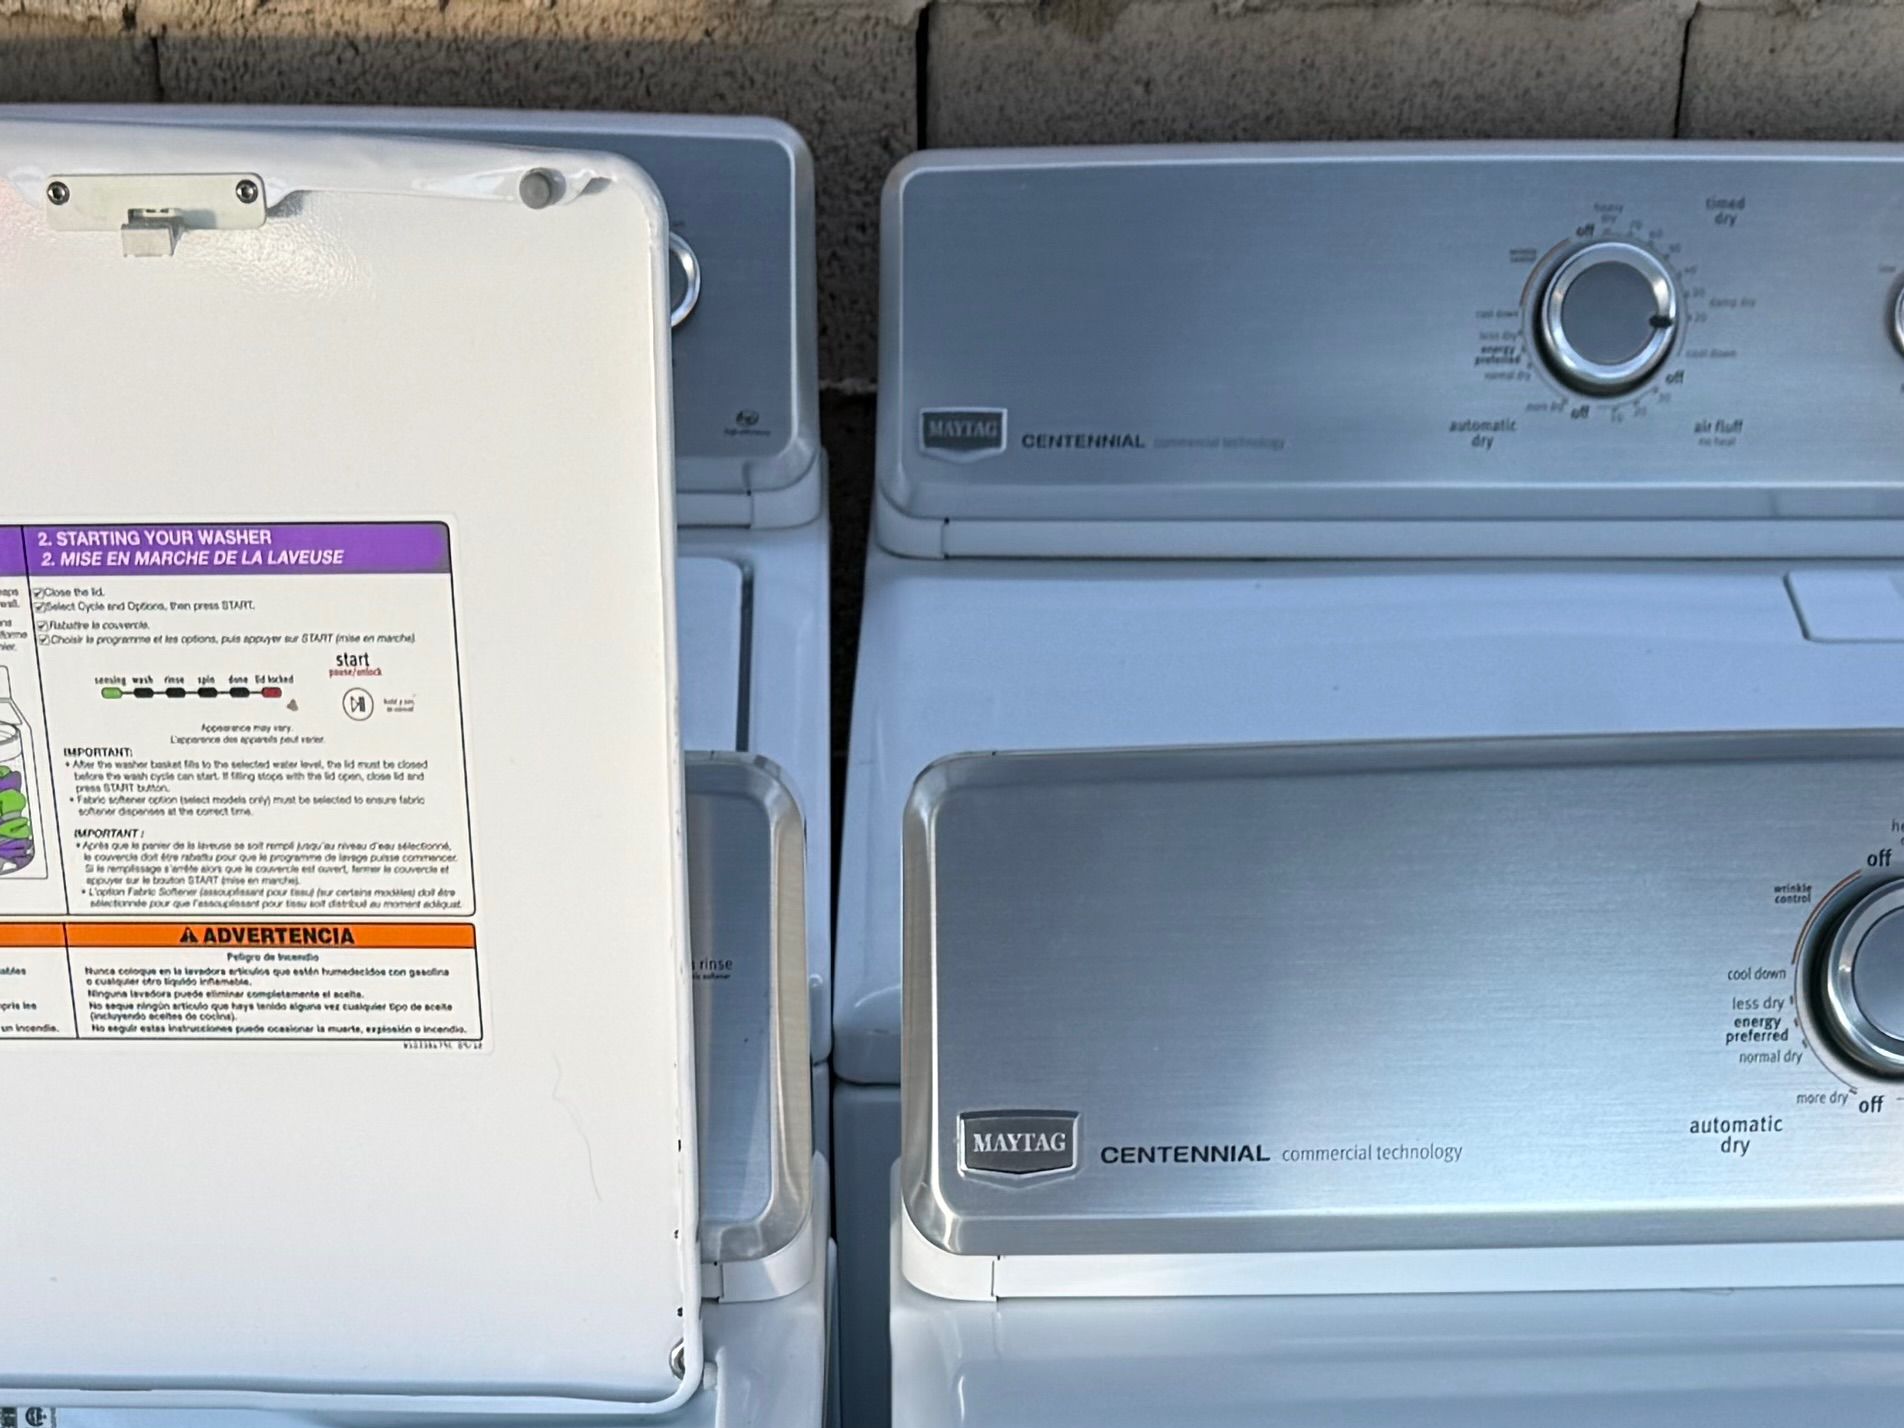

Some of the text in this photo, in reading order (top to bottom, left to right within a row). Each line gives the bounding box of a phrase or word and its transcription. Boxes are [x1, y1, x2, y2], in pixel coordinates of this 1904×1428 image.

[1705, 198, 1745, 210] timed
[1714, 212, 1737, 226] dry
[1576, 224, 1595, 237] off
[1666, 371, 1684, 385] off
[1571, 406, 1589, 420] off
[1449, 418, 1517, 432] automatic
[1694, 419, 1743, 433] air fluff
[928, 420, 997, 438] MAYTAG
[1022, 433, 1145, 449] CENTENNIAL
[1471, 433, 1494, 449] dry
[38, 529, 271, 546] 2. STARTING YOUR WASHER
[41, 549, 344, 566] 2. MISE EN MARCHE DE LA LAVEUSE
[46, 588, 71, 598] Close
[74, 588, 89, 598] the
[336, 652, 370, 667] start
[198, 675, 216, 686] spin
[63, 747, 134, 758] IMPORTANT:
[1866, 850, 1891, 868] off
[1774, 883, 1812, 894] wrinkle
[1775, 893, 1811, 904] control
[203, 927, 354, 945] ADVERTENCIA
[700, 957, 733, 970] rinse
[1727, 967, 1787, 981] cool down
[1732, 996, 1785, 1013] less dry
[1734, 1016, 1781, 1032] energy
[1725, 1028, 1789, 1044] preferred
[1739, 1050, 1803, 1066] normal dry
[1796, 1090, 1849, 1107] more dry
[1858, 1096, 1884, 1114] off
[1689, 1115, 1783, 1135] automatic
[973, 1132, 1464, 1165] MAYTAG CENTENNIAL commercial technology
[1720, 1136, 1751, 1157] dry
